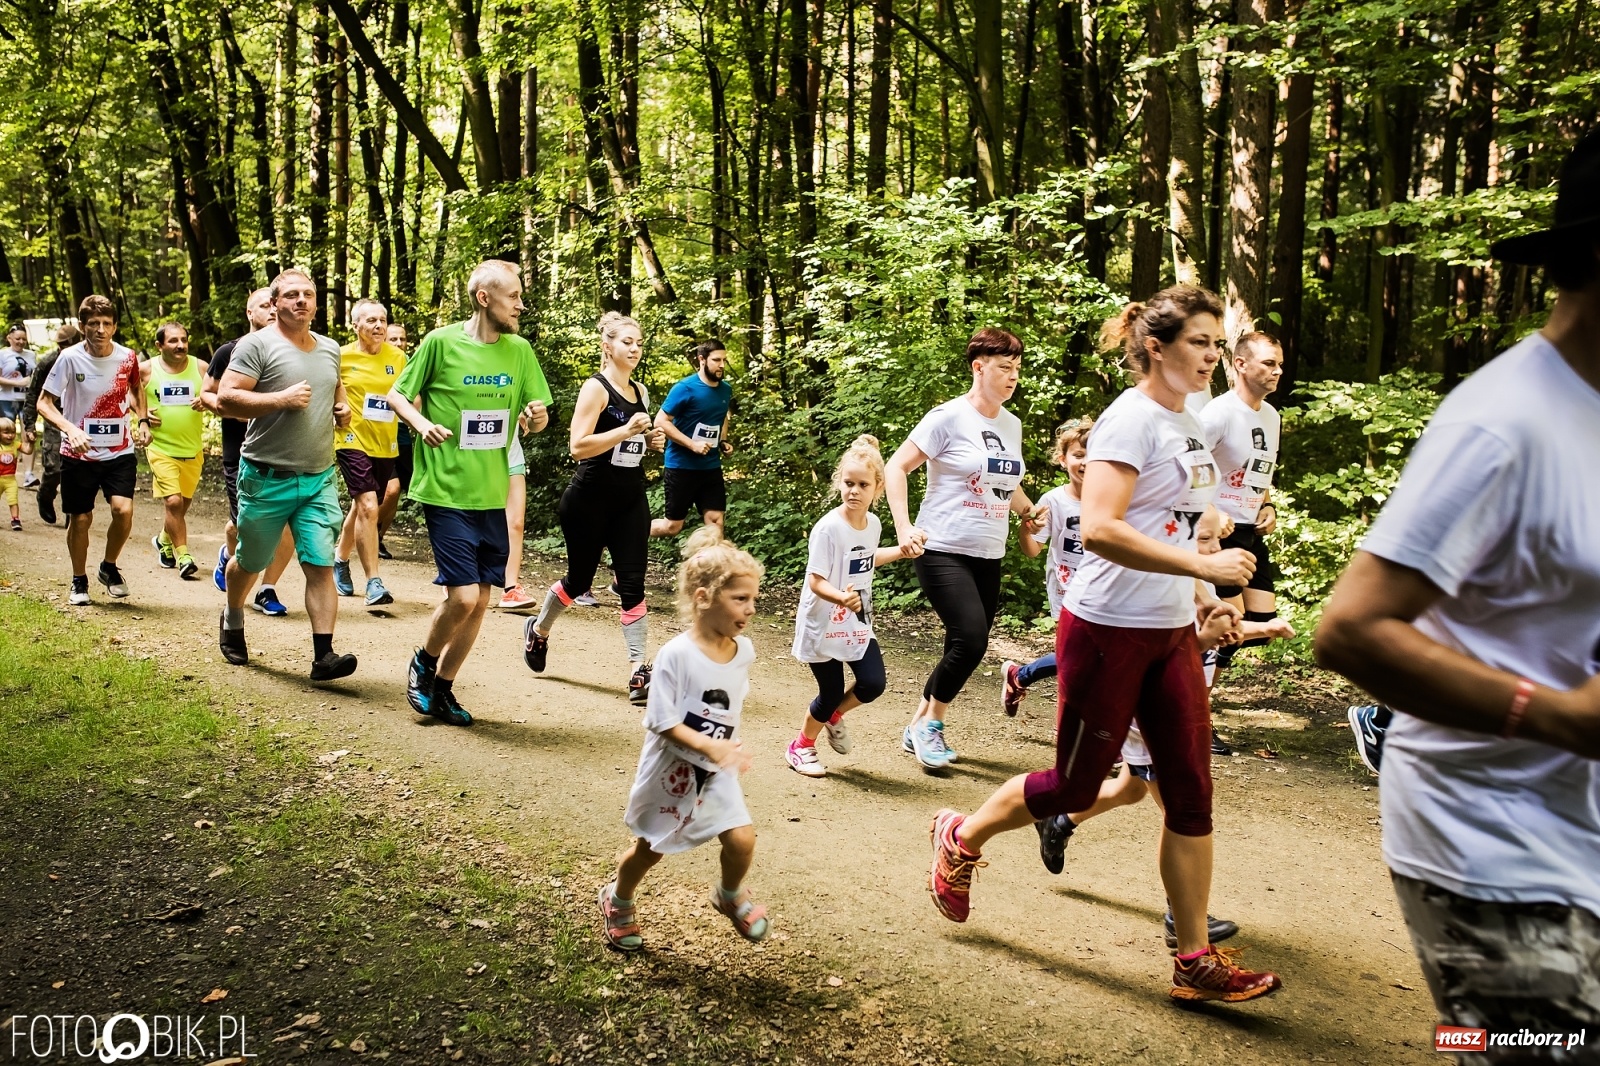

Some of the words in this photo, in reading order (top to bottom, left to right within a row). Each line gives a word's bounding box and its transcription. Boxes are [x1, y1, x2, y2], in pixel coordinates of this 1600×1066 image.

[463, 374, 514, 386] CLASSEN
[169, 387, 184, 396] 72
[375, 401, 388, 410] 41
[98, 425, 111, 434] 31
[477, 421, 495, 433] 86
[626, 442, 639, 453] 46
[997, 460, 1013, 473] 19
[962, 500, 988, 509] DANUTA
[1072, 541, 1083, 553] 2
[858, 558, 872, 572] 21
[825, 631, 849, 639] DANUTA
[1204, 649, 1217, 664] 2
[699, 721, 727, 740] 26
